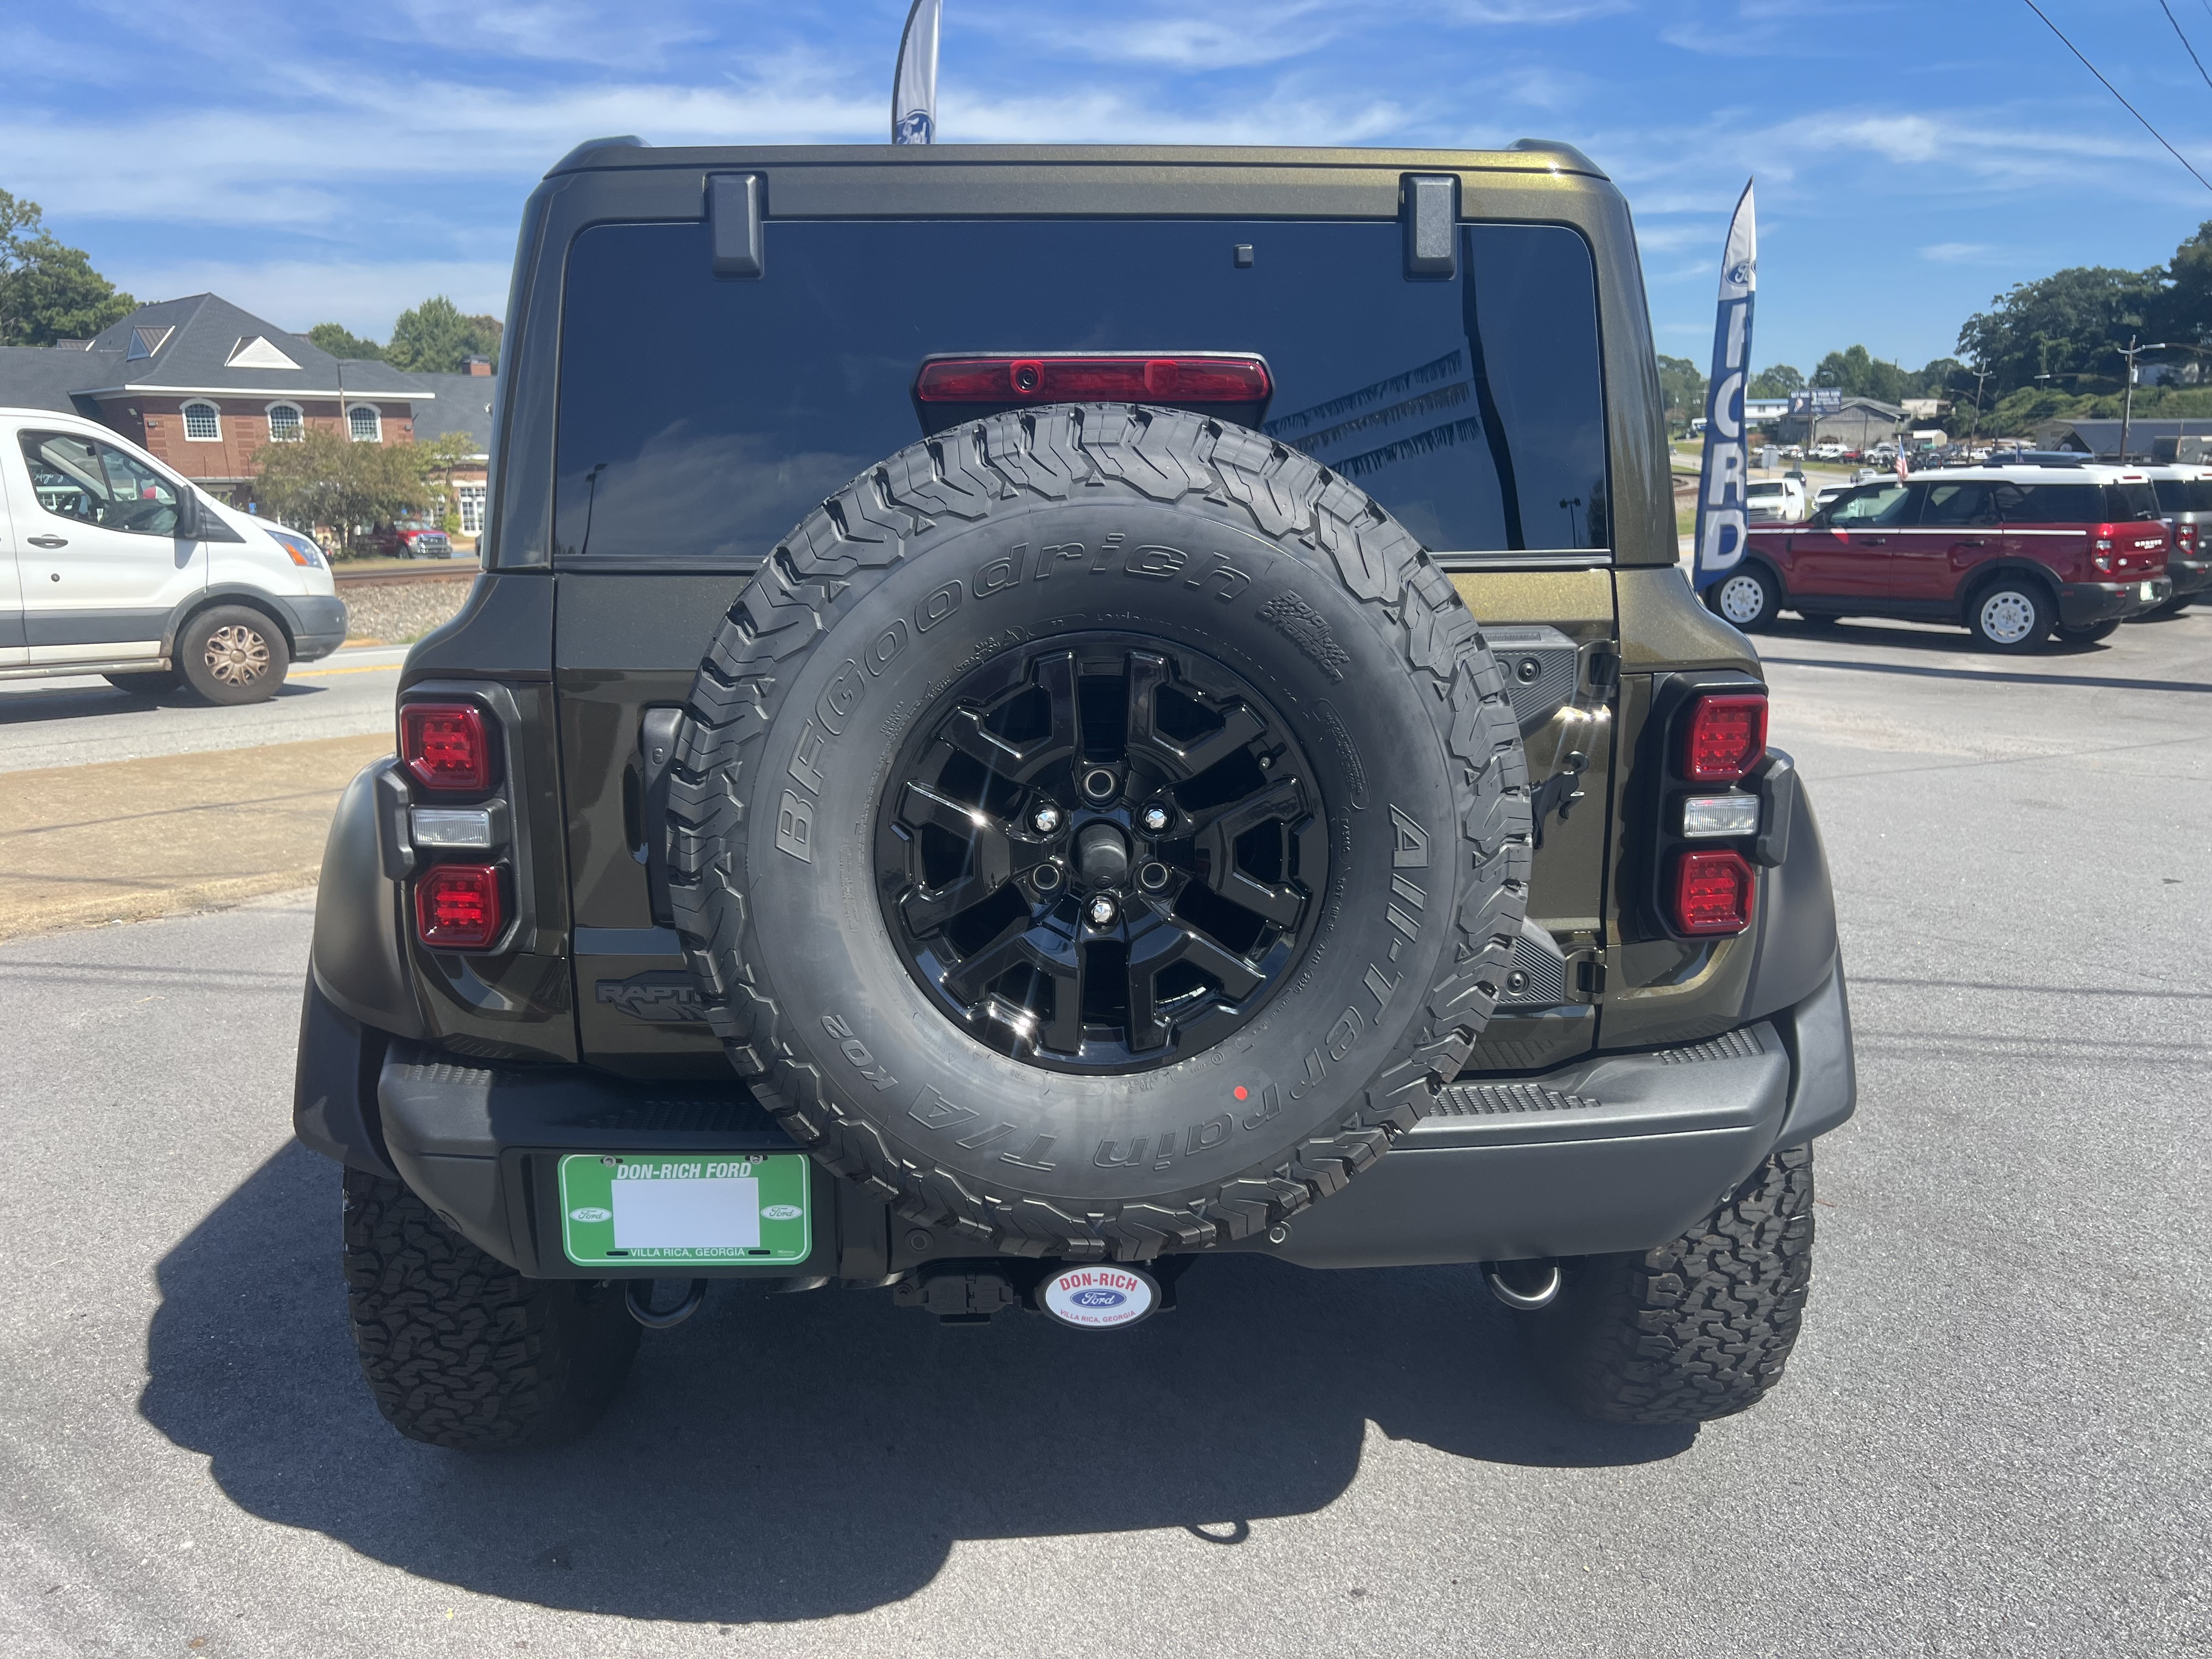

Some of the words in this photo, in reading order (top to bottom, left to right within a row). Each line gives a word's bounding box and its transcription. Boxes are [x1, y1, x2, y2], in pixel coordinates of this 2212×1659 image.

[1258, 605, 1344, 681] Champion
[956, 639, 1001, 672] TRACTION
[775, 533, 1252, 864] BFGoodrich
[597, 985, 702, 1005] RAPT
[1093, 803, 1429, 1170] All-Terrain
[821, 1014, 898, 1090] KO2
[908, 1084, 1057, 1171] T/A
[617, 1164, 701, 1180] DON-RICH
[706, 1163, 752, 1178] FORD
[578, 1210, 603, 1221] Ford
[769, 1207, 795, 1218] Ford
[630, 1248, 661, 1257] VILLA
[663, 1248, 692, 1258] RICA,
[695, 1247, 745, 1257] GEORGIA
[1059, 1273, 1138, 1291] DON-RICH
[1081, 1292, 1115, 1305] Ford
[1060, 1309, 1079, 1321] VILLA
[1103, 1311, 1136, 1323] GEORGIA
